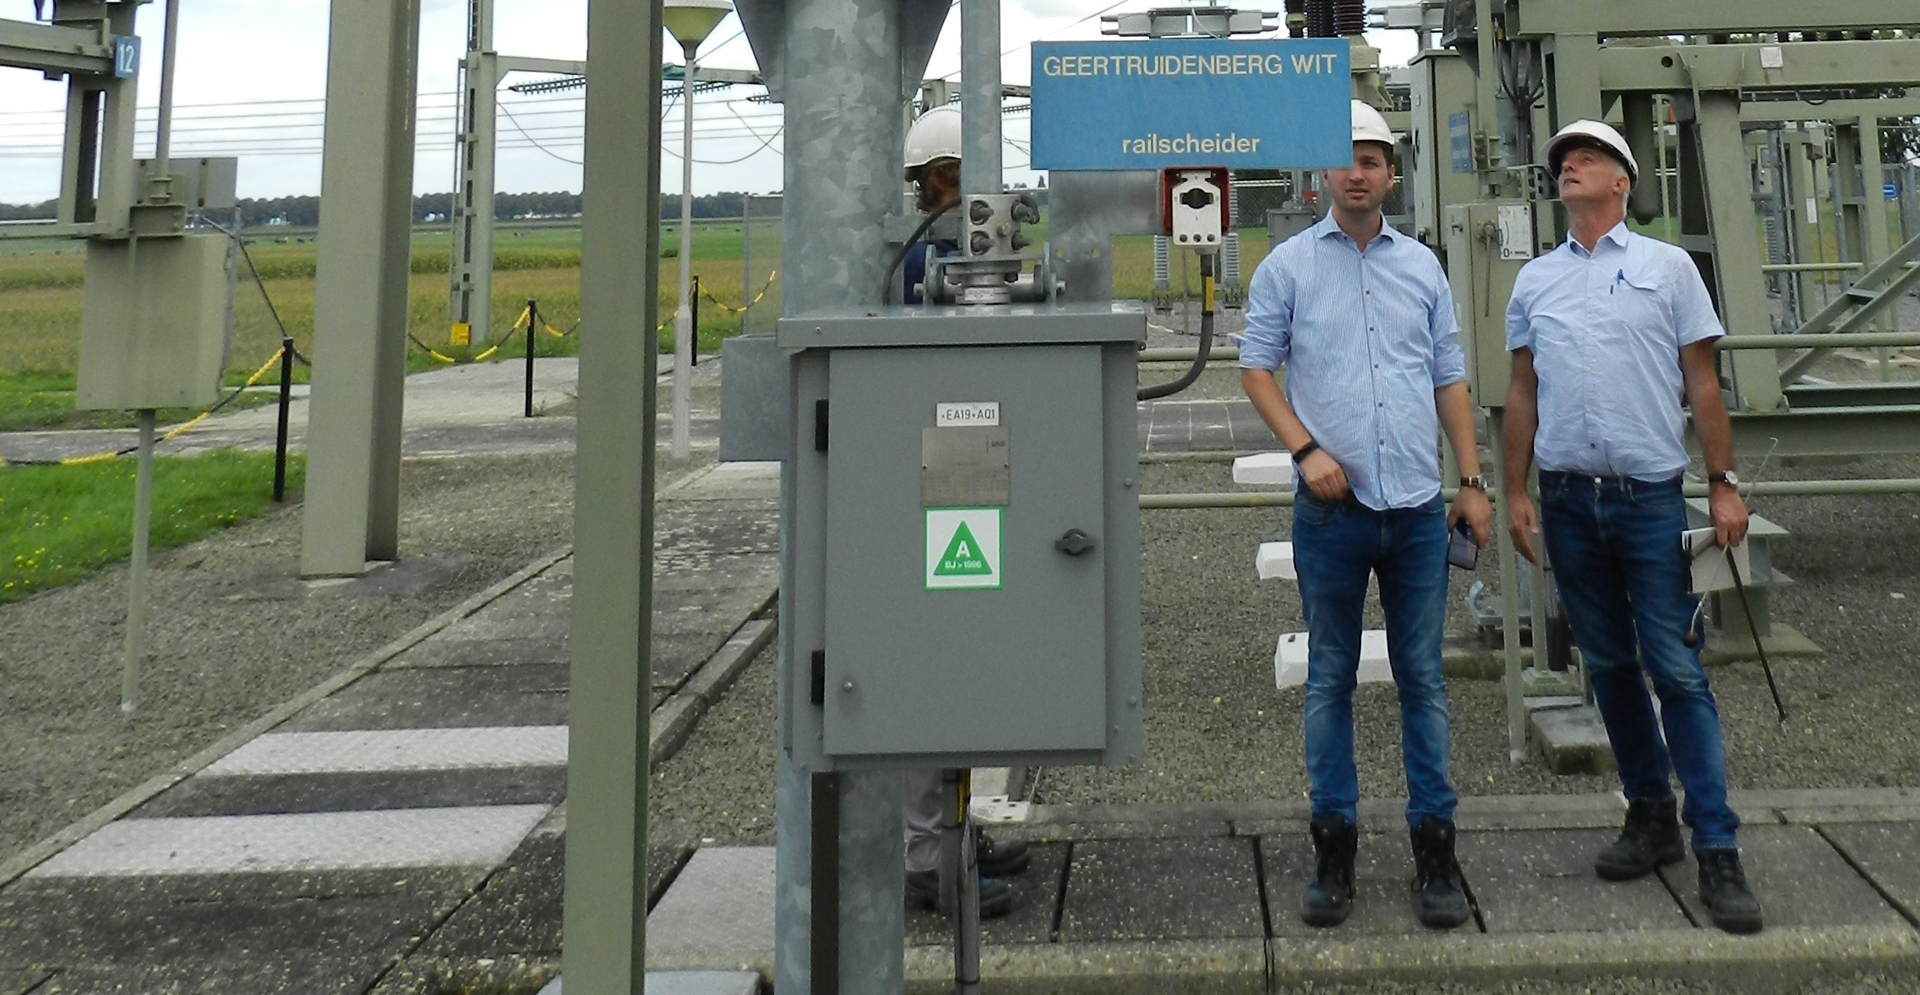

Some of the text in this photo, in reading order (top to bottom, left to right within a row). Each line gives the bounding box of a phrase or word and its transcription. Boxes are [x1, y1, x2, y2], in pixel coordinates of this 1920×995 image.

[119, 44, 134, 72] 12
[1043, 54, 1337, 76] GEERTRUIDENBERG WIT
[1122, 133, 1260, 154] railscheider
[955, 540, 971, 558] A
